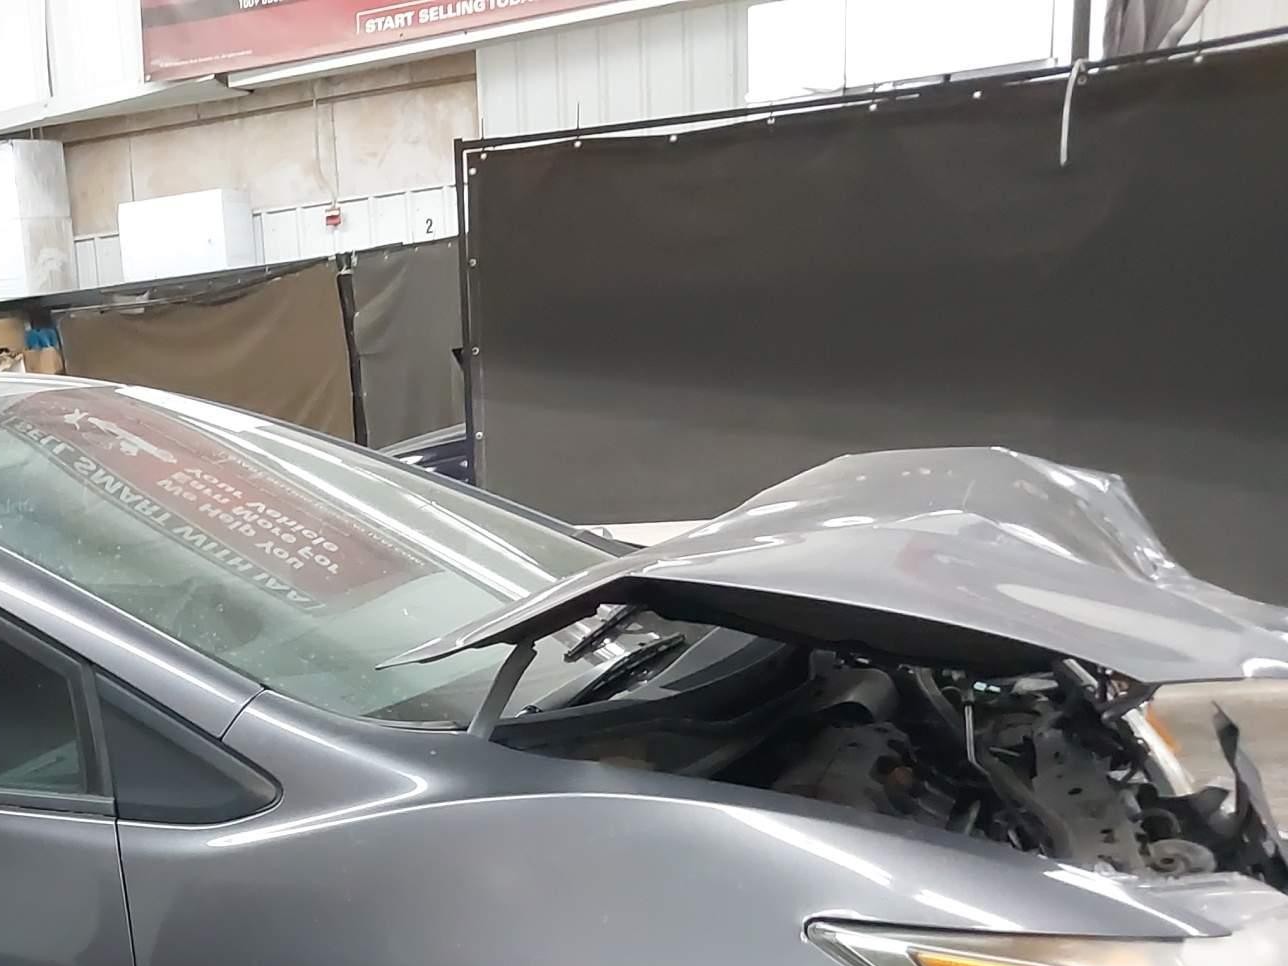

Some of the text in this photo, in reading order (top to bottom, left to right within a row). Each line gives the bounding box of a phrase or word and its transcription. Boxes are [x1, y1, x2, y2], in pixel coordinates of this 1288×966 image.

[364, 11, 415, 34] START
[418, 1, 486, 24] SELLING
[425, 217, 433, 234] 2
